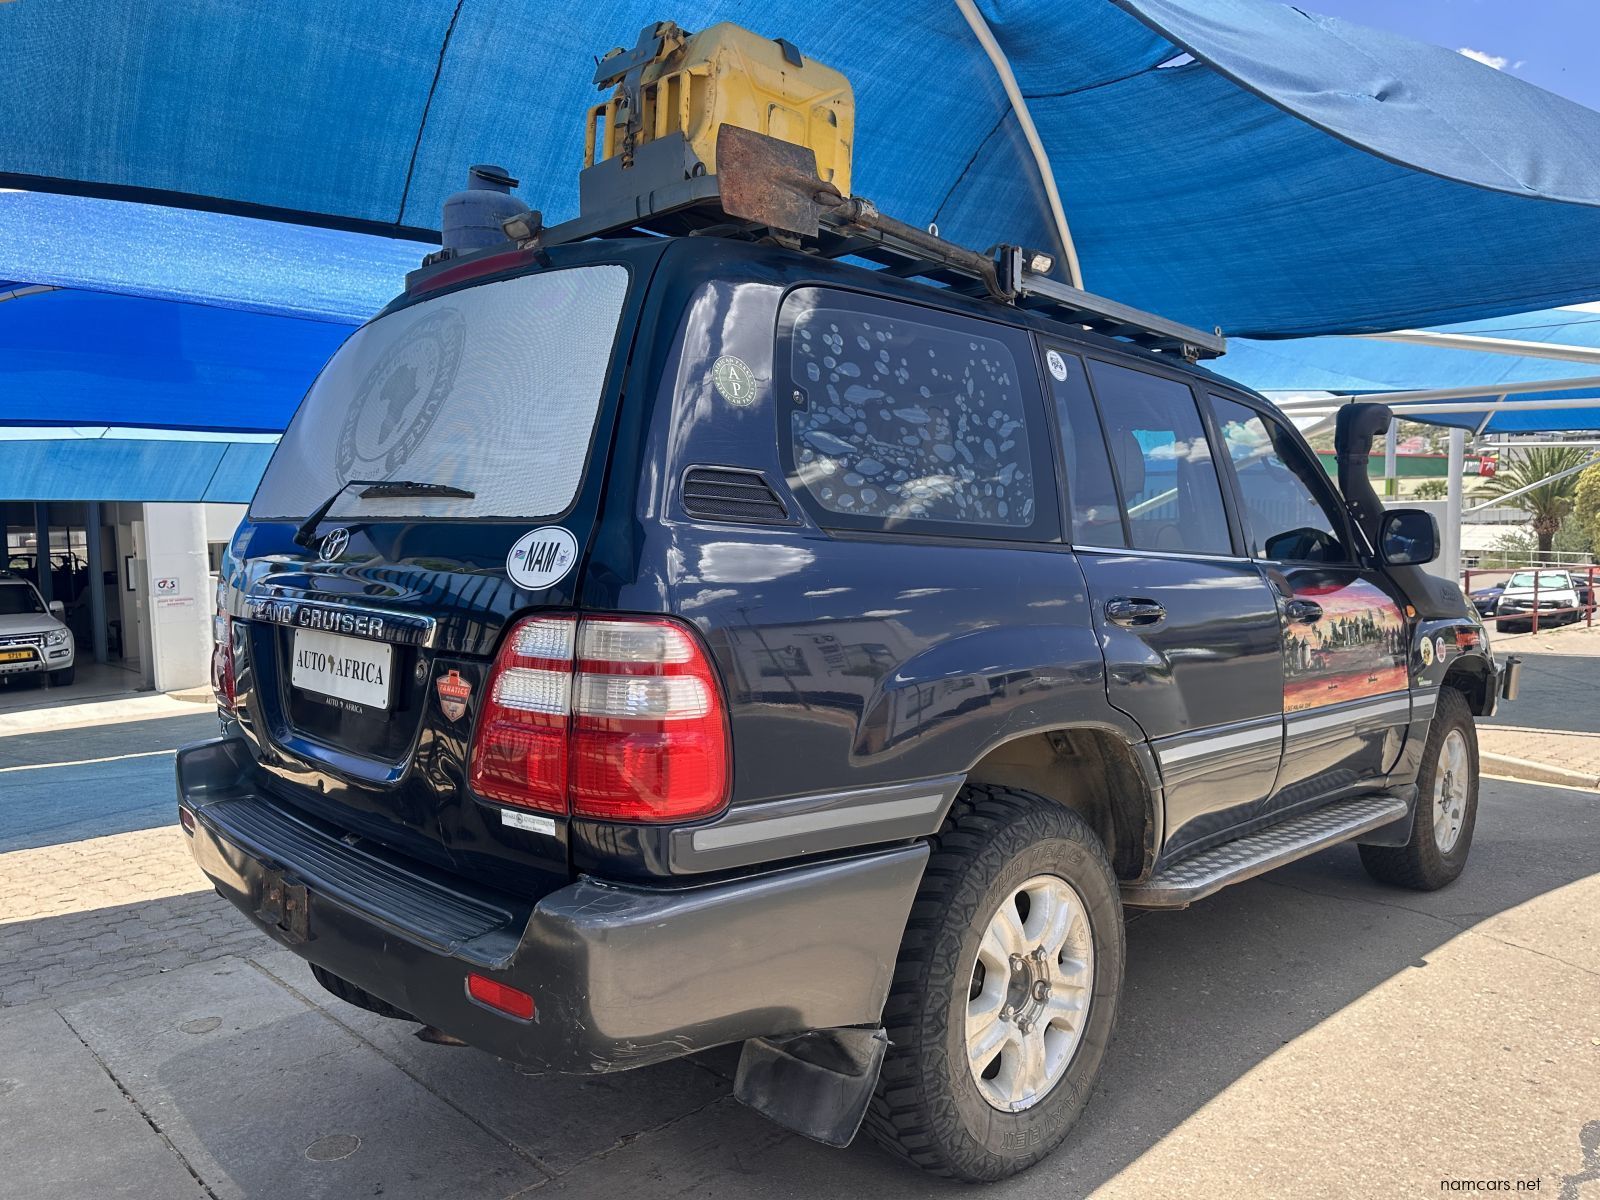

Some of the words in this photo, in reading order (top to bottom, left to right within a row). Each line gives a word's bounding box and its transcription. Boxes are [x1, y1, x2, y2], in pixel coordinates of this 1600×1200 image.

[729, 366, 740, 380] A
[731, 382, 741, 396] P
[523, 542, 561, 572] NAM
[300, 607, 384, 638] CRUISER
[296, 650, 326, 673] AUTO
[335, 659, 383, 686] AFRICA
[440, 684, 467, 696] FANATICS
[326, 697, 339, 707] AUTO
[344, 702, 363, 714] AFRICA
